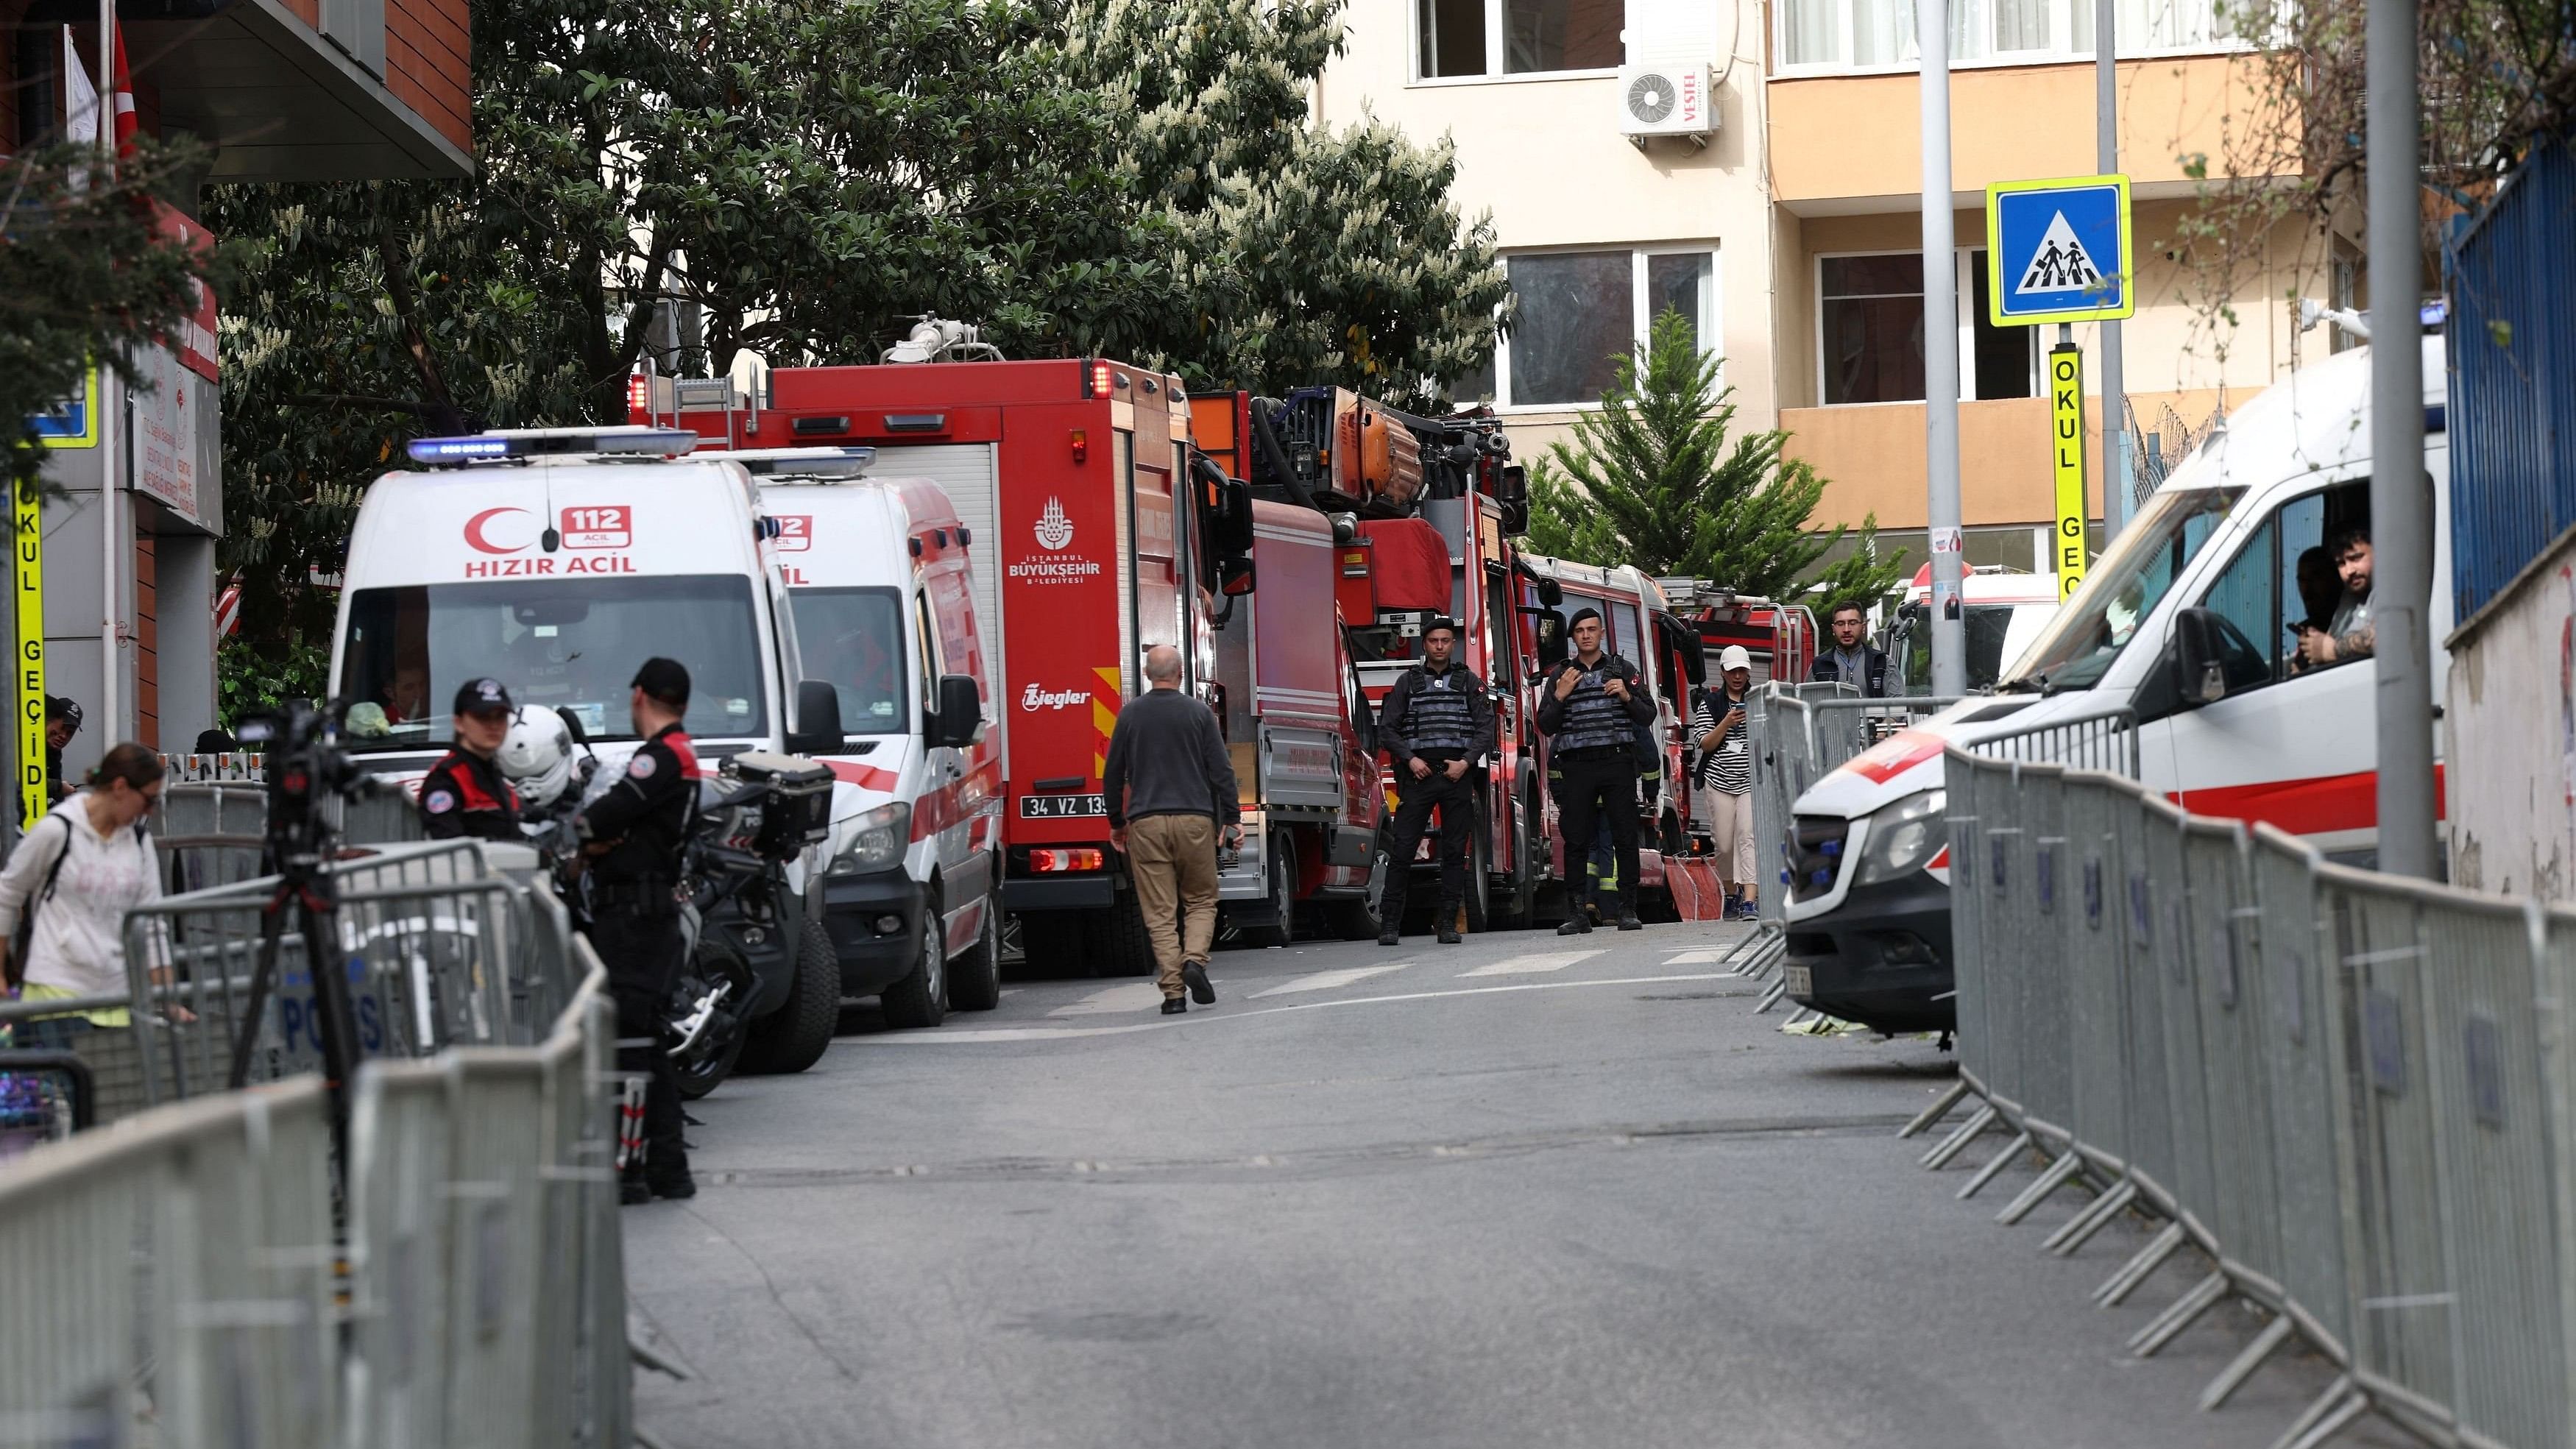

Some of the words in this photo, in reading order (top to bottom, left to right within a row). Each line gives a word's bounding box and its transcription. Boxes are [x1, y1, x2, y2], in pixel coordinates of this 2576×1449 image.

[1684, 71, 1696, 121] VESTEL
[2056, 361, 2075, 467] OKUL
[572, 509, 622, 530] 112
[466, 558, 554, 578] HIZIR
[566, 552, 637, 574] ACİL
[1009, 560, 1100, 578] BÜYÜKŞEHİR
[1026, 554, 1083, 562] İSTANBUL
[1022, 683, 1091, 712] Ziegler
[24, 640, 42, 819] GEÇİDİ
[1030, 798, 1049, 815] 34
[1058, 797, 1077, 815] VZ
